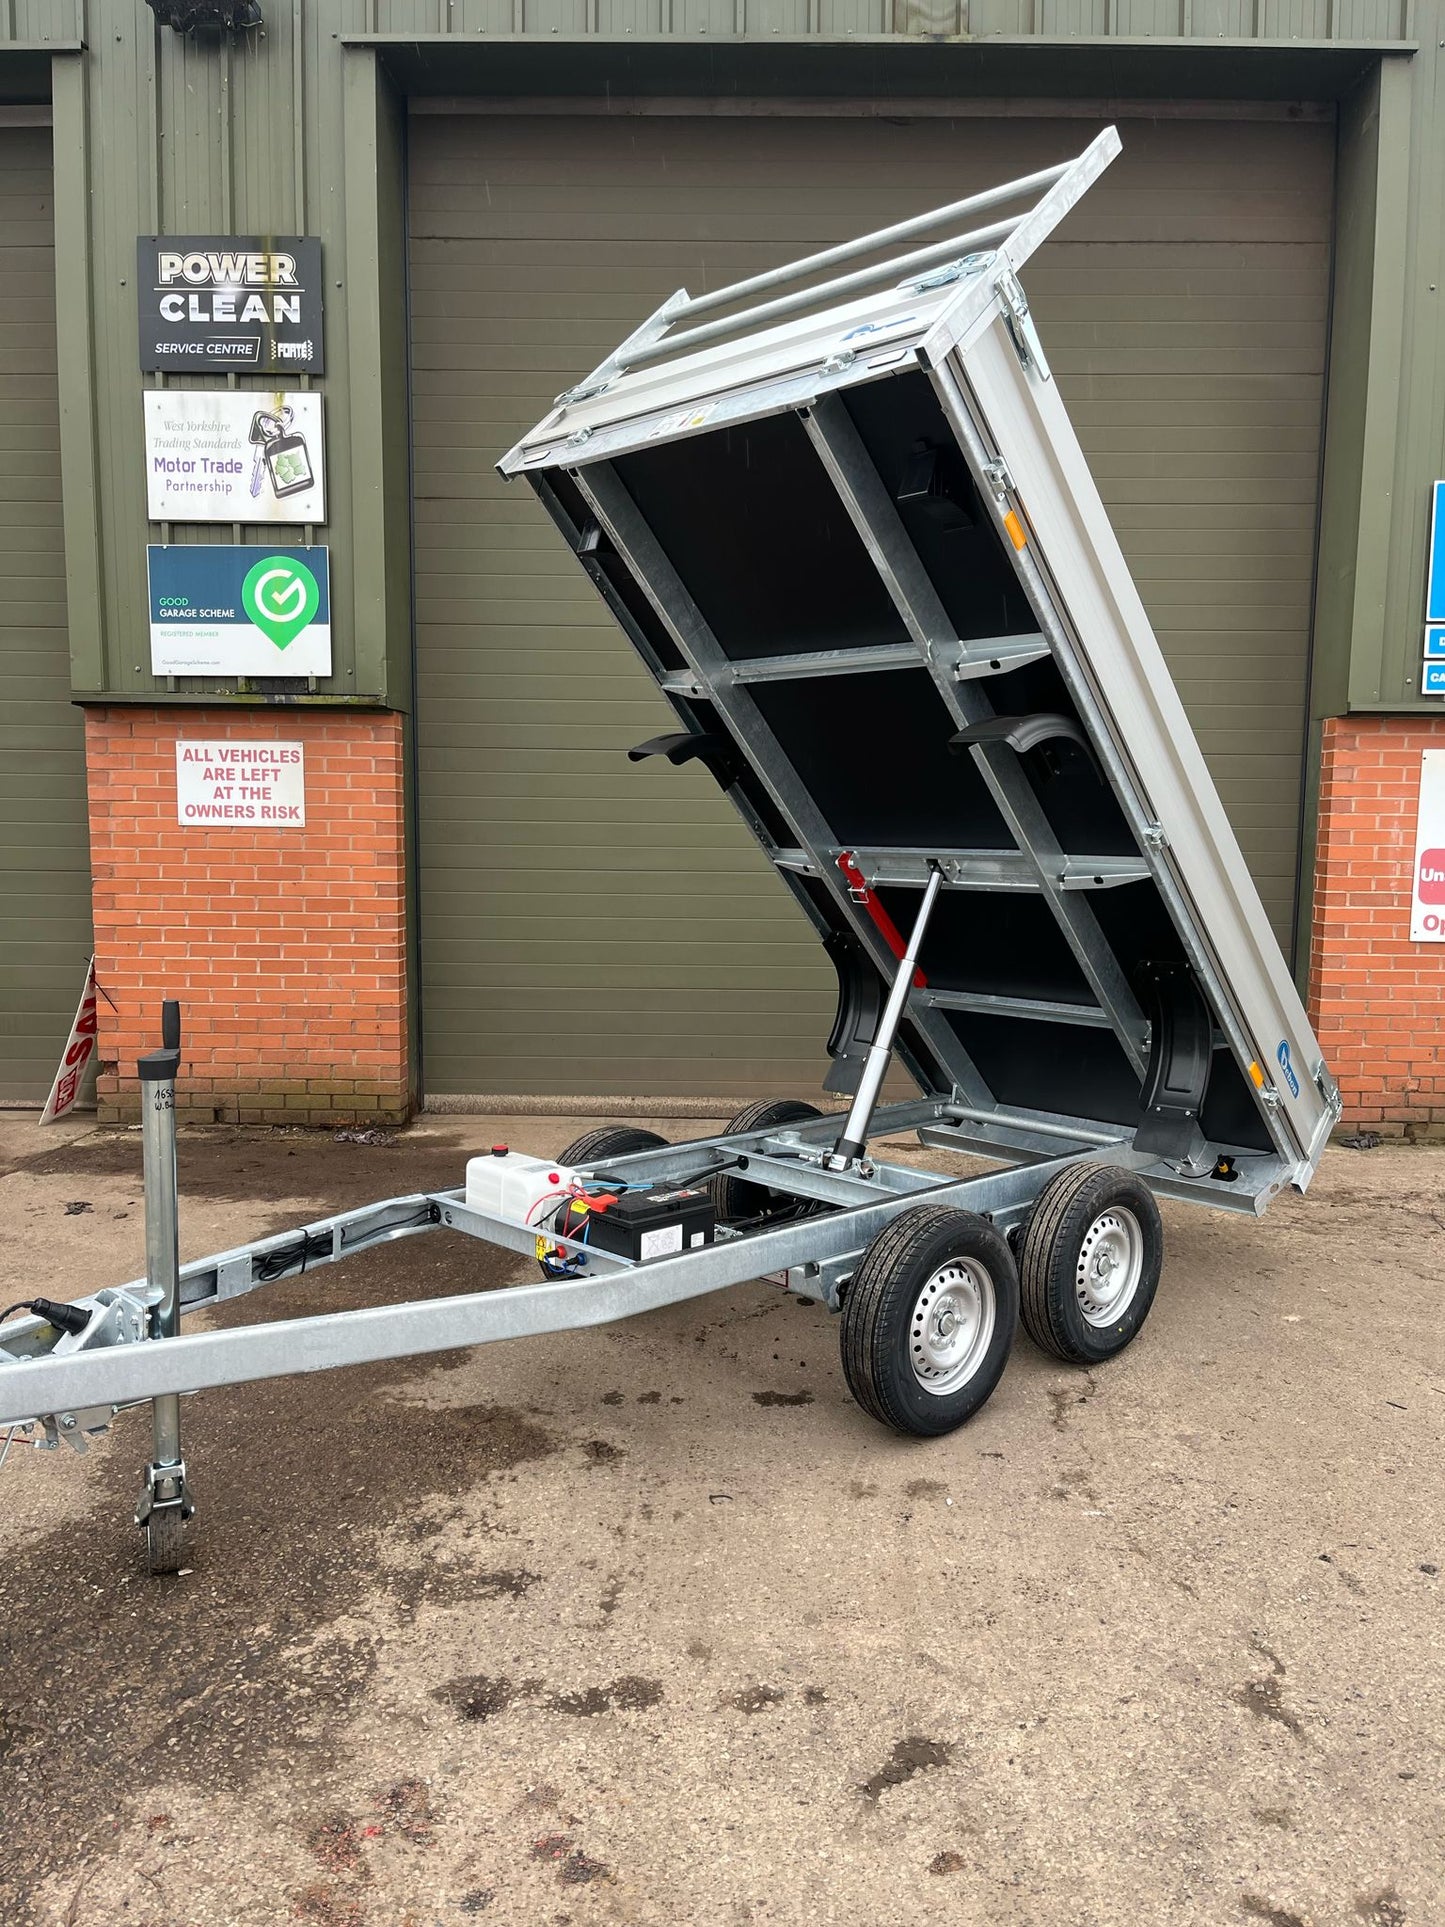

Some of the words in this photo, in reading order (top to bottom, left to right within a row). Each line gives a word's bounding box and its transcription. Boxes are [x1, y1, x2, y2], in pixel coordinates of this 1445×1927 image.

[158, 252, 299, 286] POWER
[159, 293, 301, 323] CLEAN
[155, 343, 204, 354] SERVICE
[206, 343, 253, 355] CENTRE
[163, 421, 184, 432] West
[187, 421, 231, 433] Yorkshire
[153, 437, 190, 450] Trading
[193, 438, 242, 450] Standards
[154, 457, 196, 473] Motor
[201, 458, 243, 474] Trade
[166, 479, 233, 496] Partnership
[159, 597, 189, 606] GOOD
[159, 609, 197, 618] GARAGE
[199, 609, 235, 618] SCHEME
[183, 749, 213, 762] ALL
[218, 749, 300, 764] VEHICLES
[203, 768, 236, 781] ARE
[241, 768, 281, 782] LEFT
[213, 786, 234, 799] AT
[239, 786, 272, 800] THE
[185, 804, 255, 818] OWNERS
[261, 806, 300, 819] RISK
